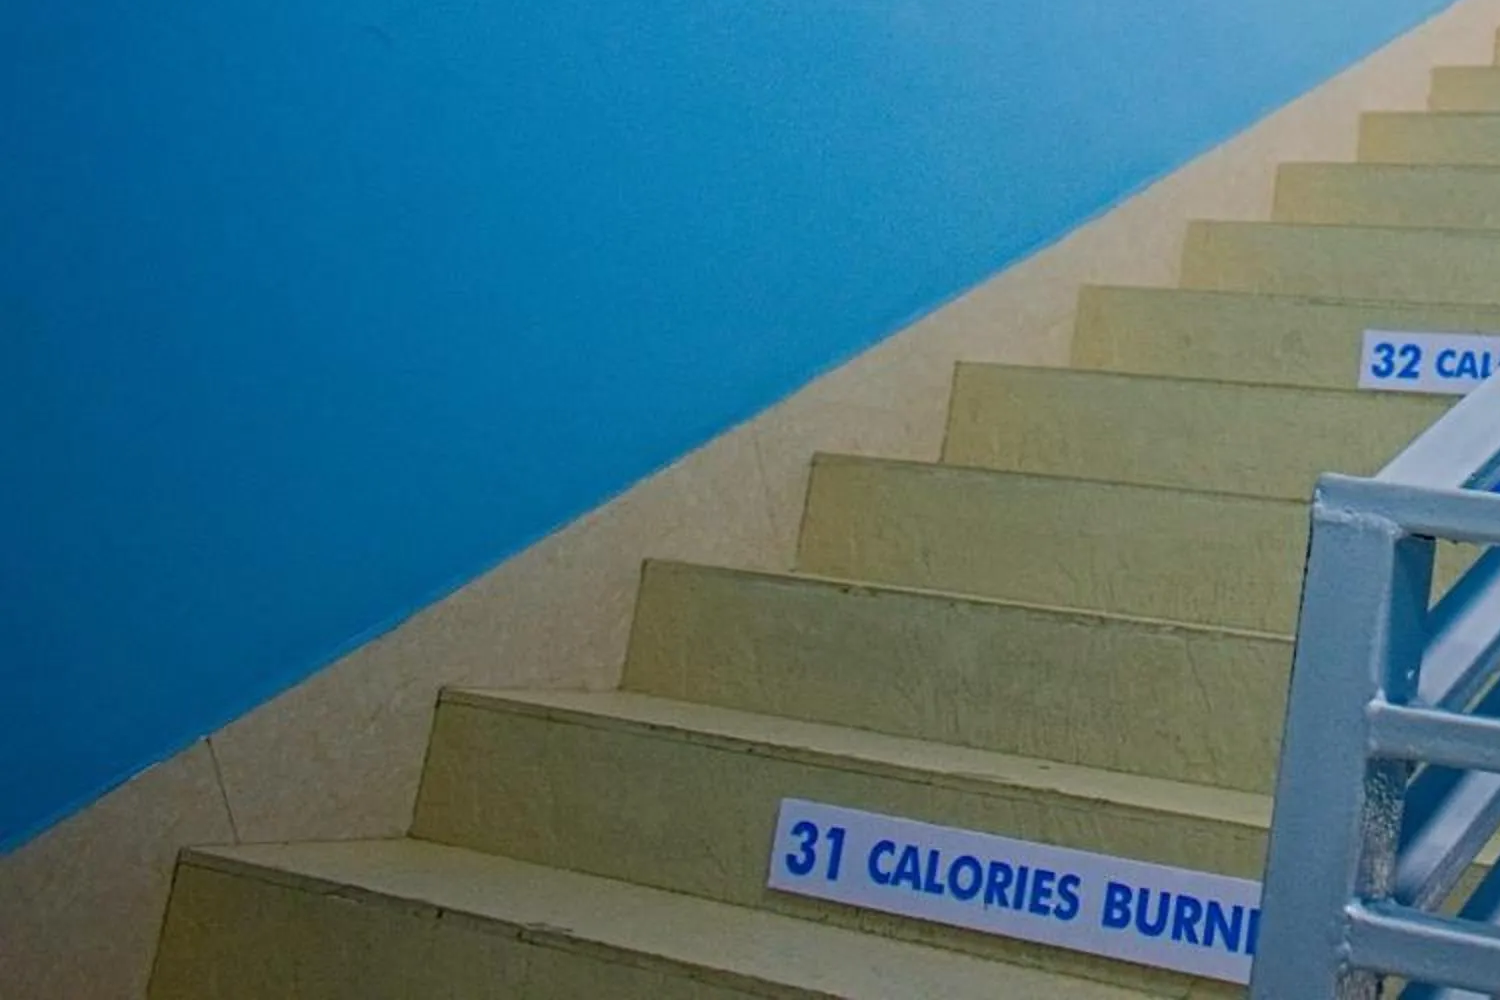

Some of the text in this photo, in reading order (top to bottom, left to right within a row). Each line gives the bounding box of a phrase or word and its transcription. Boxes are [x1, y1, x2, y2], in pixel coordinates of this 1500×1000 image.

[1371, 342, 1423, 380] 32
[785, 820, 847, 881] 31
[868, 840, 1081, 920] CALORIES
